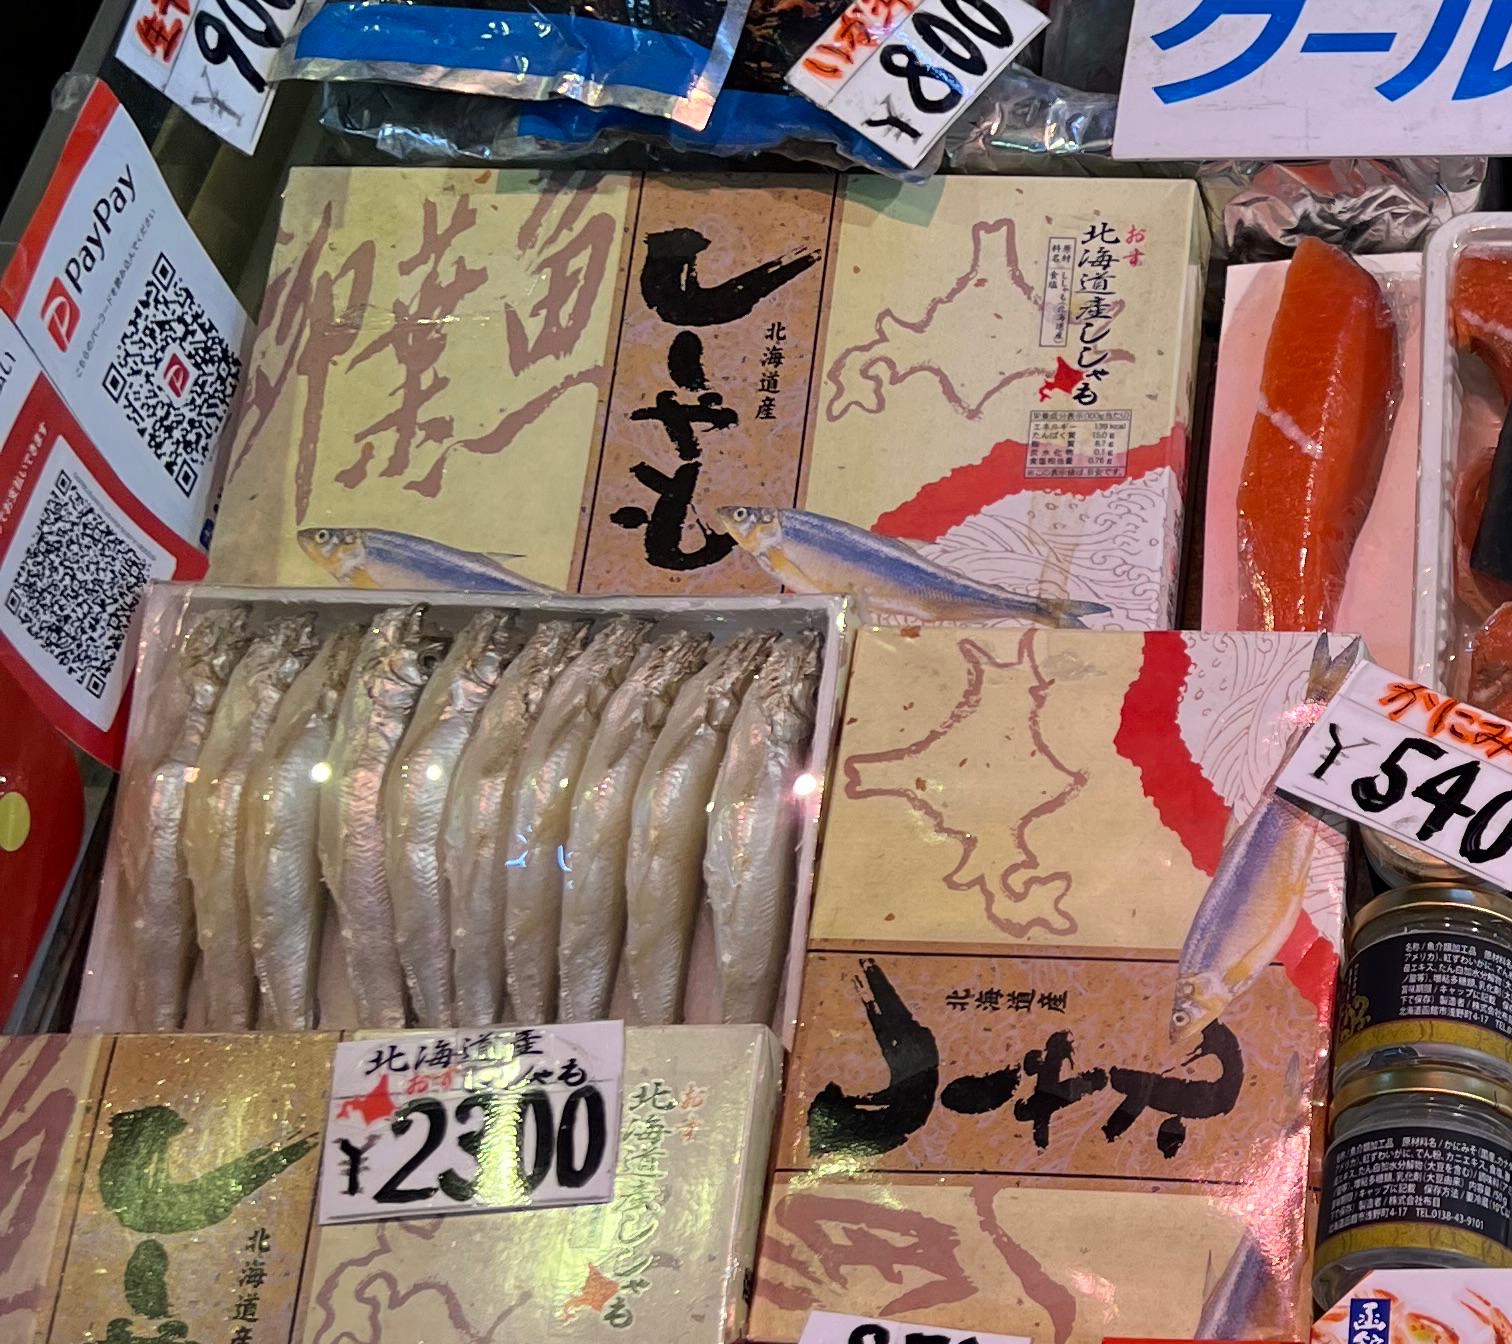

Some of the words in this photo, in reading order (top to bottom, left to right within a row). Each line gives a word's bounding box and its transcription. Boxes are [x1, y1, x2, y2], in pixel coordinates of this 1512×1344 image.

[1072, 222, 1121, 406] 北海道産ししゃも
[755, 321, 787, 421] 北海道産
[944, 986, 1070, 1014] 北海道産
